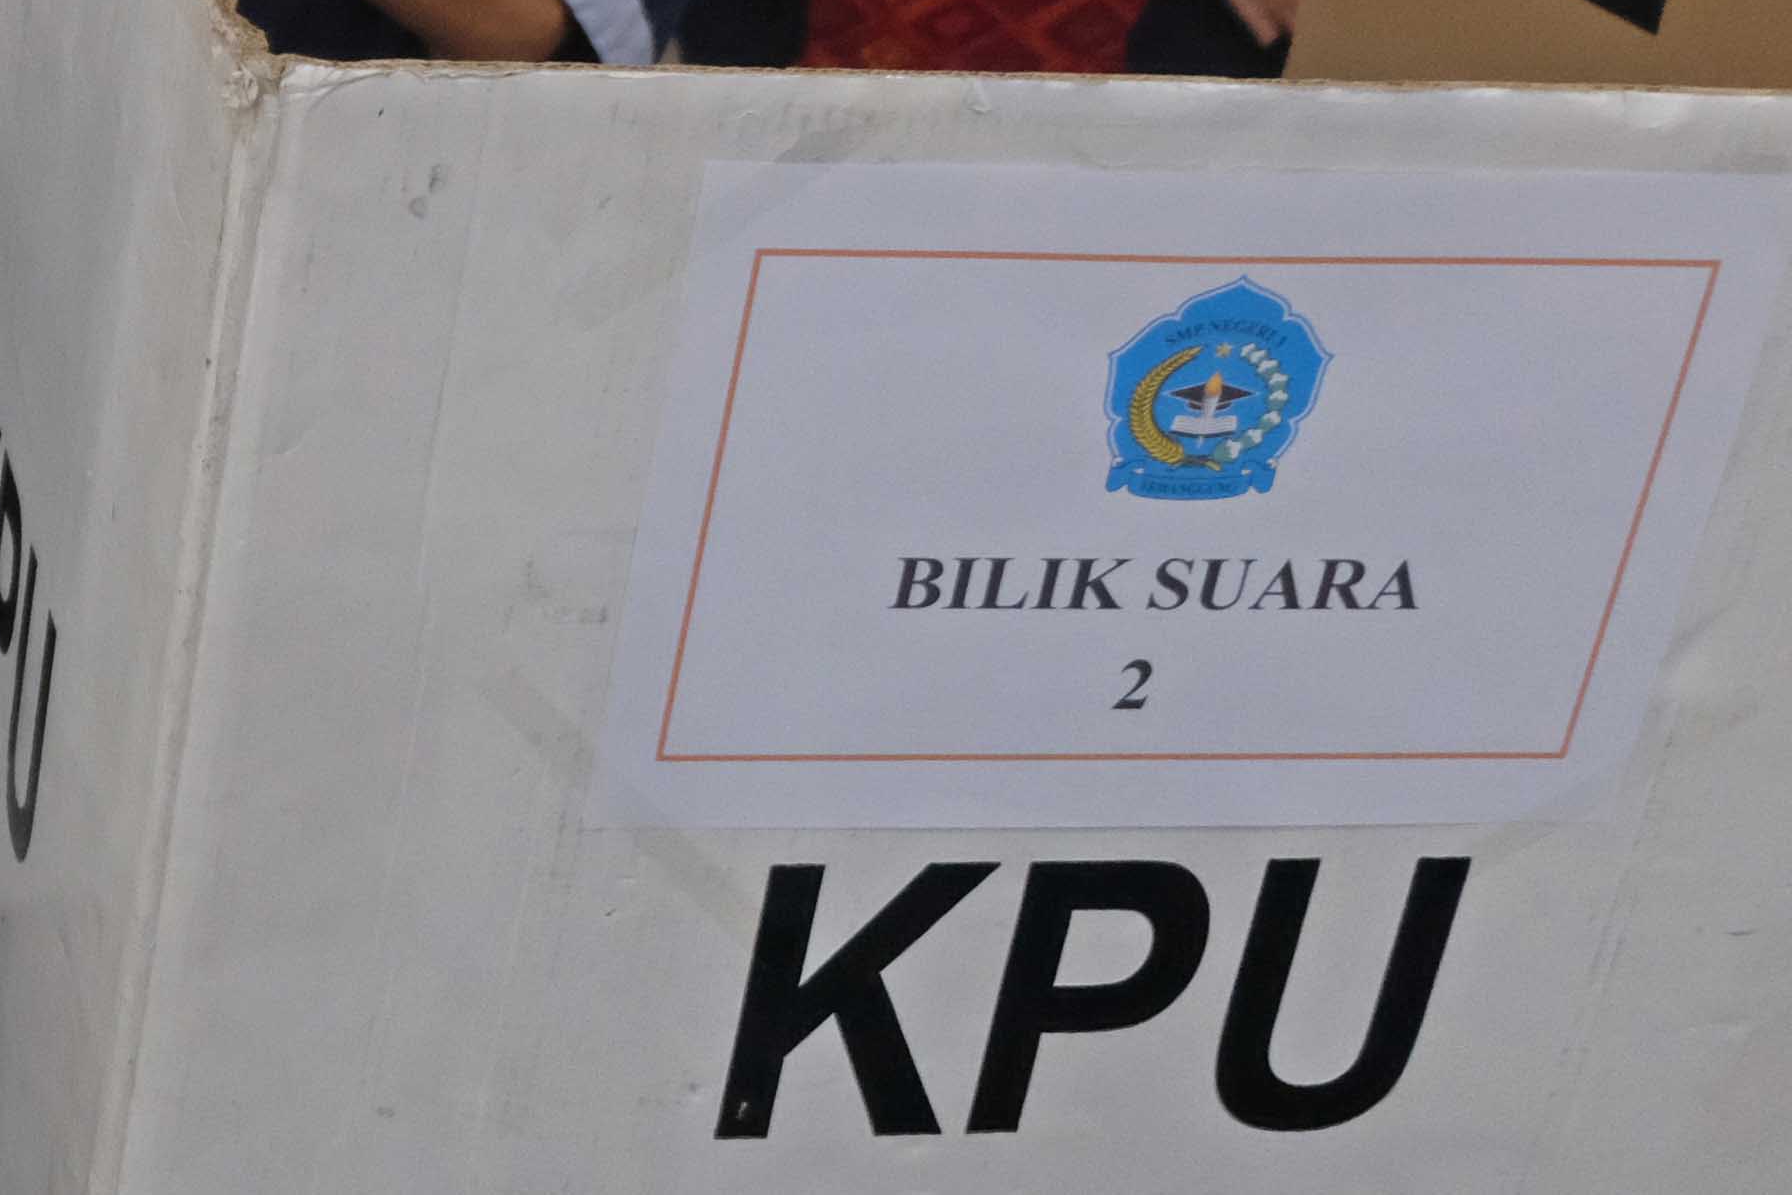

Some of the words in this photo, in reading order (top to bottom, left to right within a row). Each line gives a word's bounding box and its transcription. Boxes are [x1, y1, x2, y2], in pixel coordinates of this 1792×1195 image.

[889, 557, 1132, 610] BILIK
[1145, 557, 1421, 611] SUARA
[1112, 658, 1153, 710] 2
[713, 856, 1472, 1140] KPU
